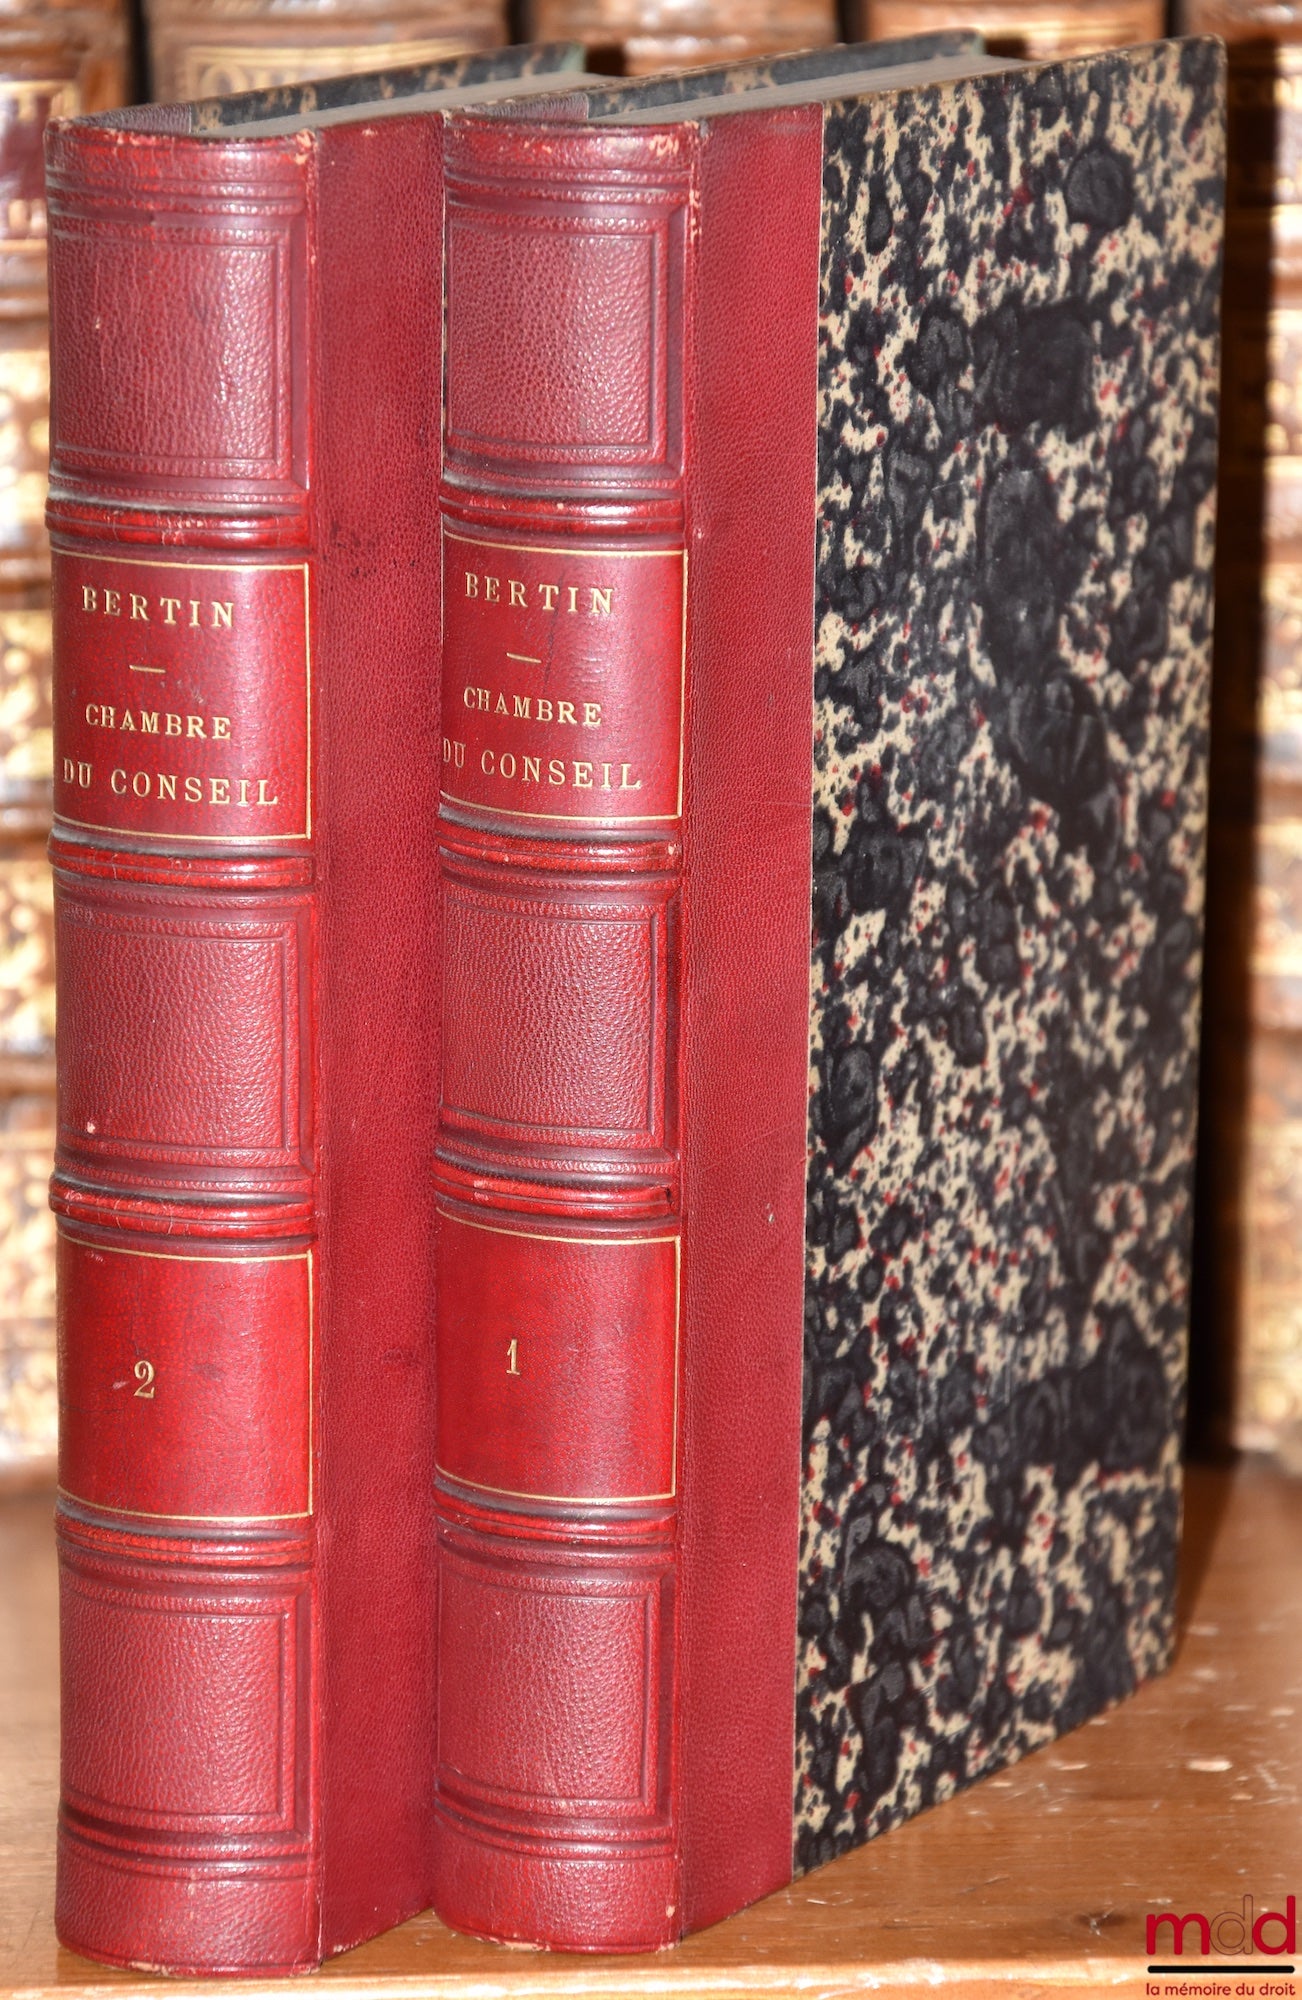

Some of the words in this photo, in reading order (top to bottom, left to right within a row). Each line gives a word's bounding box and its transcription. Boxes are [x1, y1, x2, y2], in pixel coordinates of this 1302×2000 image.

[81, 585, 235, 627] BERTIN
[464, 571, 614, 615] BERTIN
[85, 703, 232, 741] CHAMBRE
[463, 686, 602, 727] CHAMBRE
[63, 758, 93, 788] DU
[110, 768, 279, 806] CONSEIL
[442, 737, 467, 769] DU
[480, 750, 643, 790] CONSEIL
[506, 1338, 521, 1376] 1
[133, 1360, 155, 1399] 2
